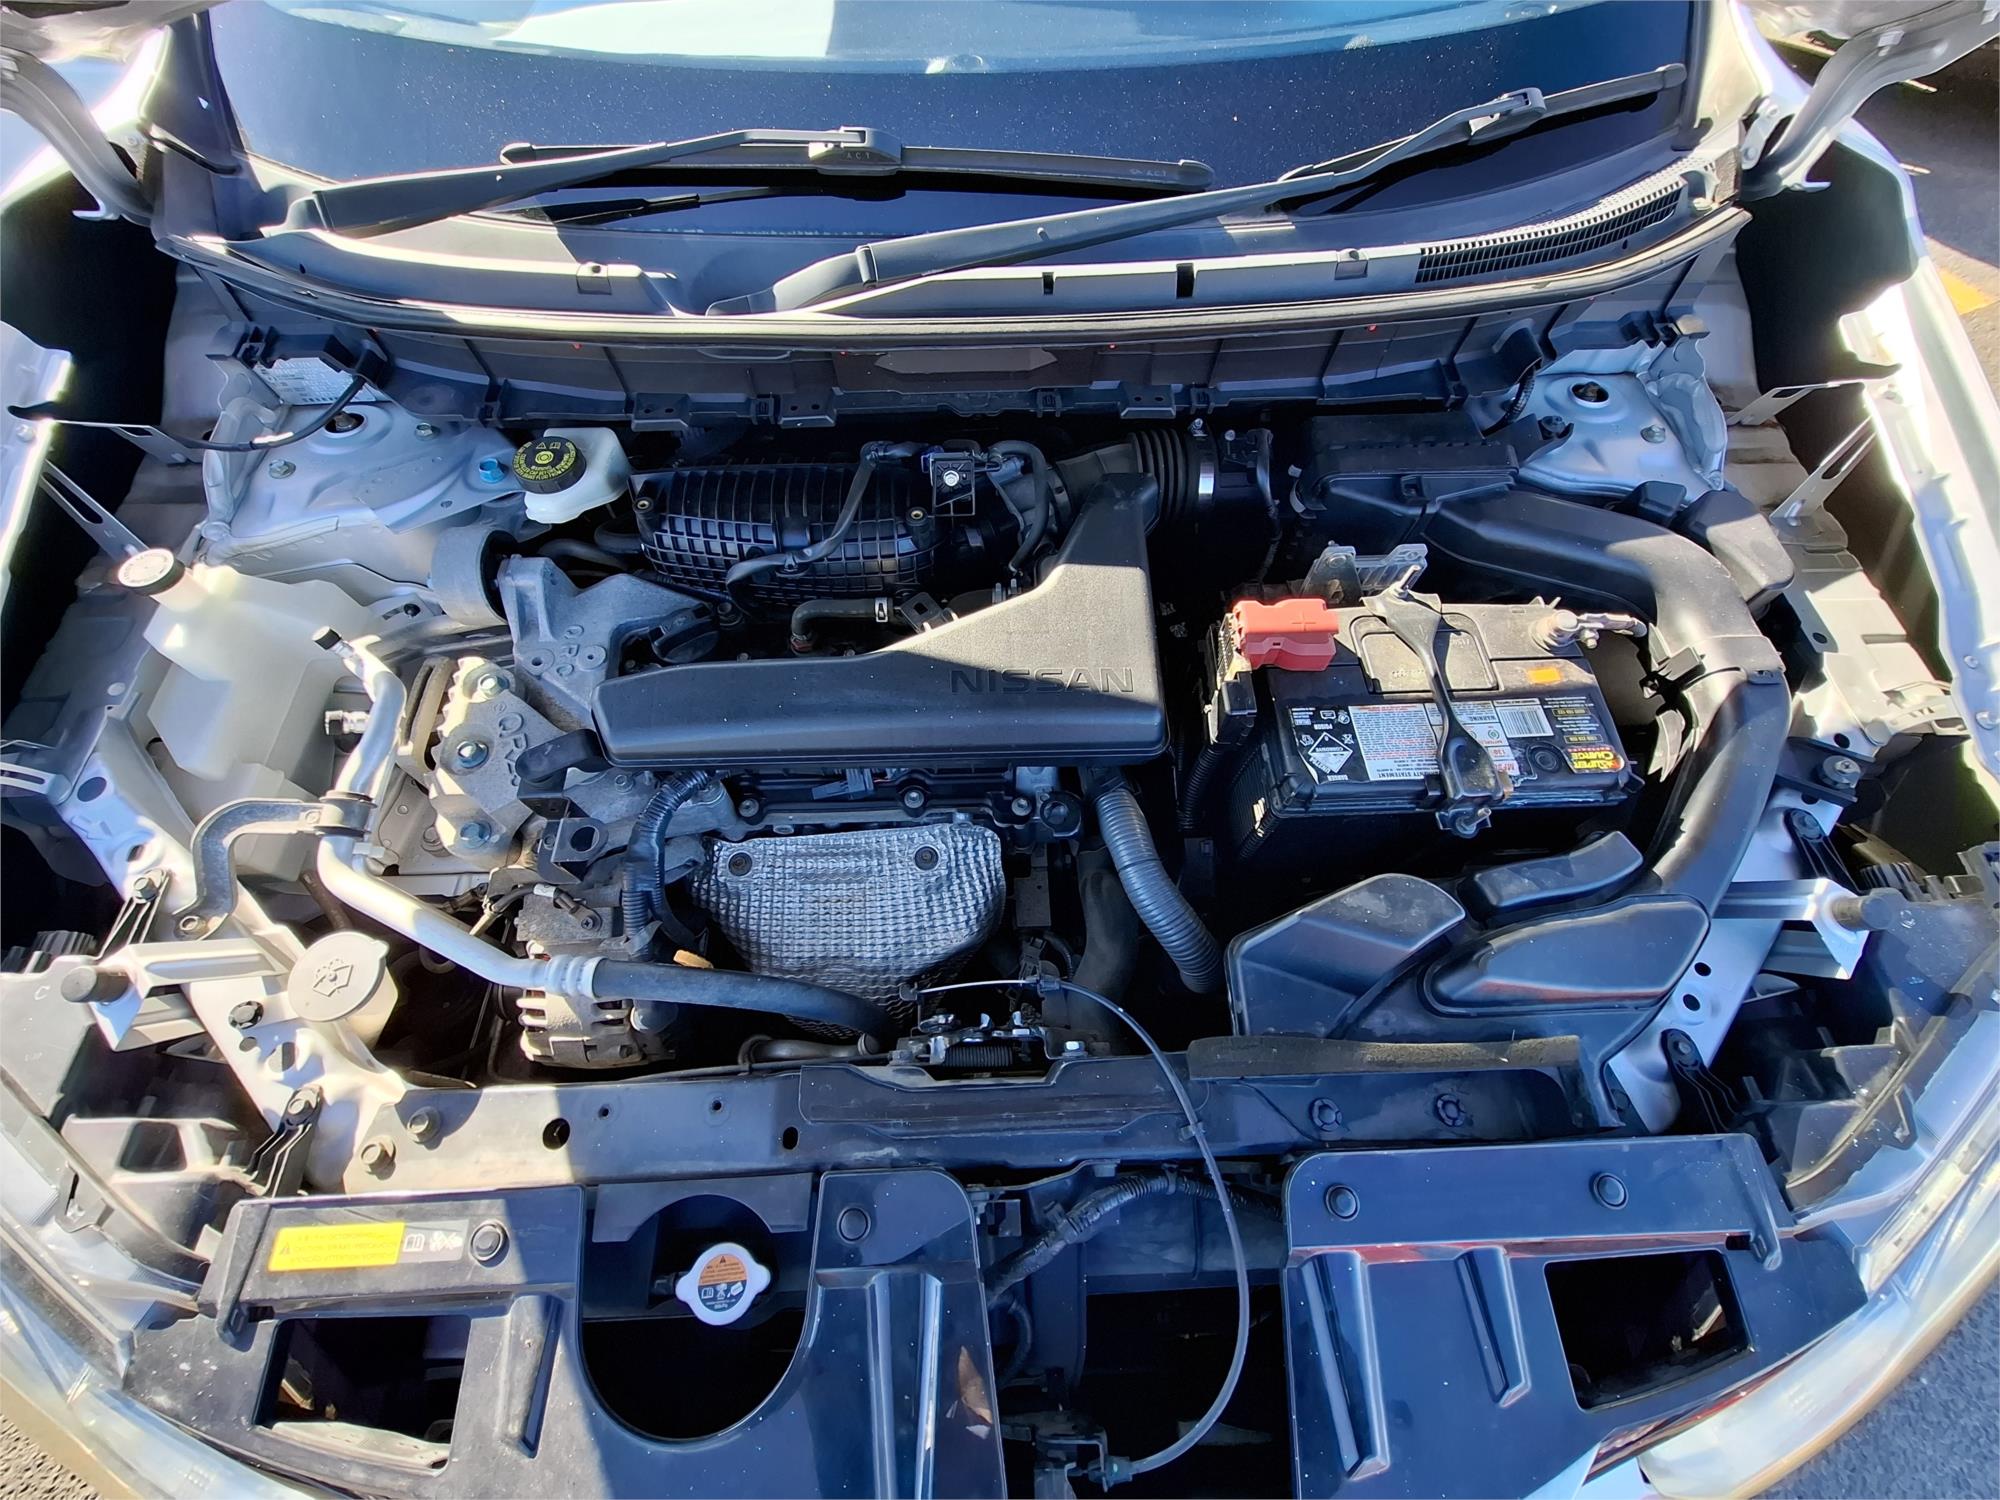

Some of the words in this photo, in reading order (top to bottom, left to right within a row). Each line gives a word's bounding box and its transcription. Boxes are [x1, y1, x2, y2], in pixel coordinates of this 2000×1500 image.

[950, 667, 1134, 694] NISSAN
[1571, 751, 1614, 760] CHARGE
[1574, 760, 1609, 770] SUPER
[1377, 771, 1411, 779] STATEMENT
